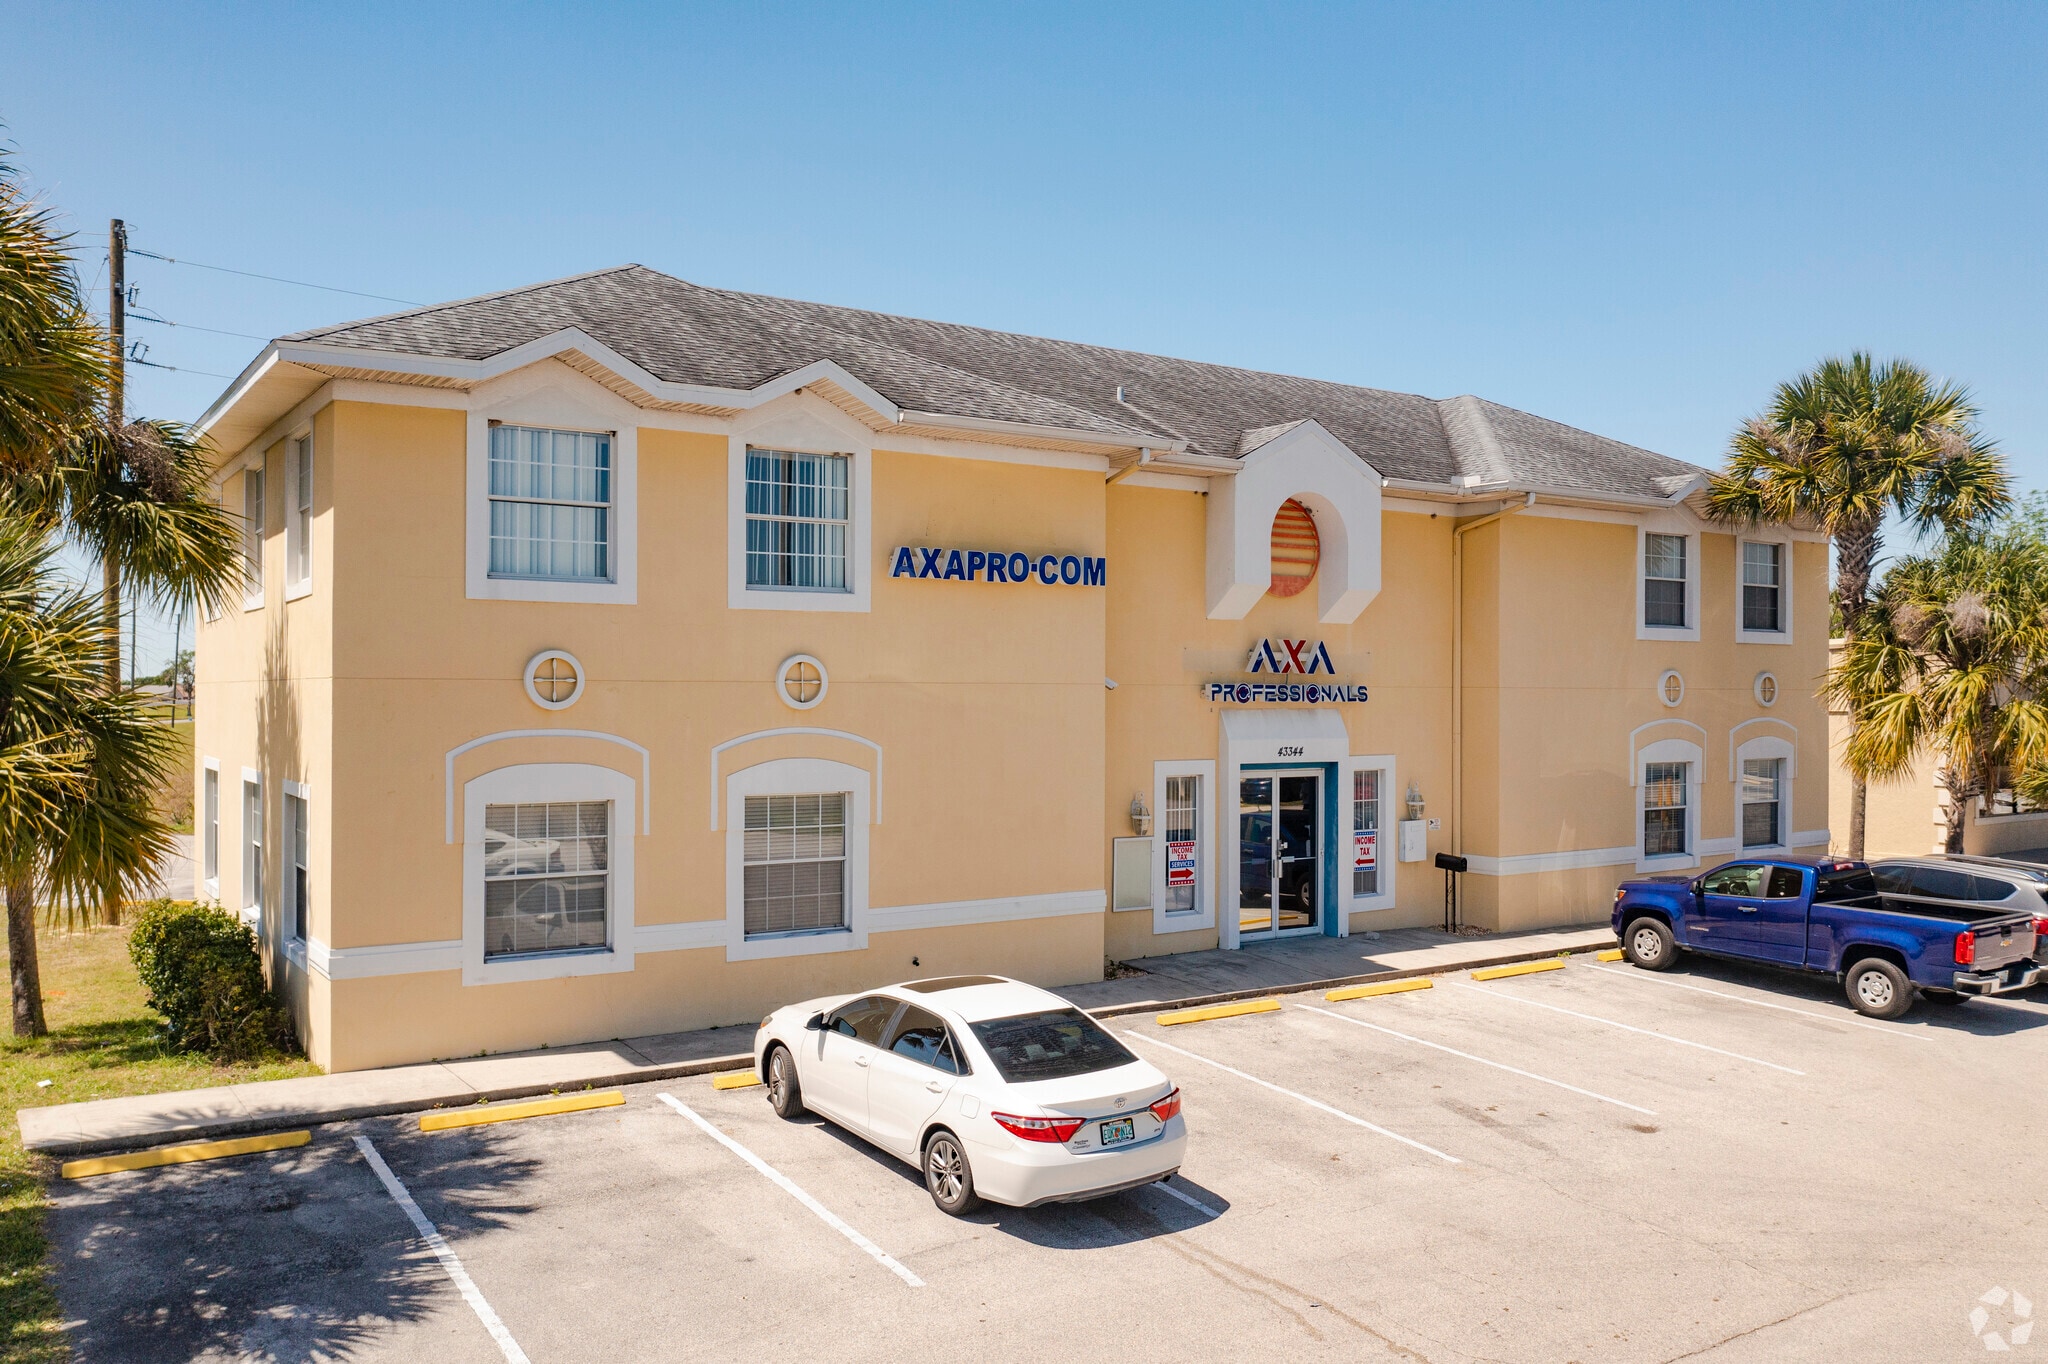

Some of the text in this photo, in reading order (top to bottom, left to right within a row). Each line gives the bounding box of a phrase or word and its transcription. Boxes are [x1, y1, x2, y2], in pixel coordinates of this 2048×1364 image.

[1248, 638, 1335, 675] AXA
[1210, 683, 1368, 704] PROFESSIONALS
[1277, 746, 1304, 757] 43344
[1355, 836, 1376, 845] INCOME
[1171, 846, 1193, 855] INCOME
[1360, 847, 1371, 856] TAX
[1176, 853, 1188, 861] TAX
[1171, 860, 1194, 868] SERVICES
